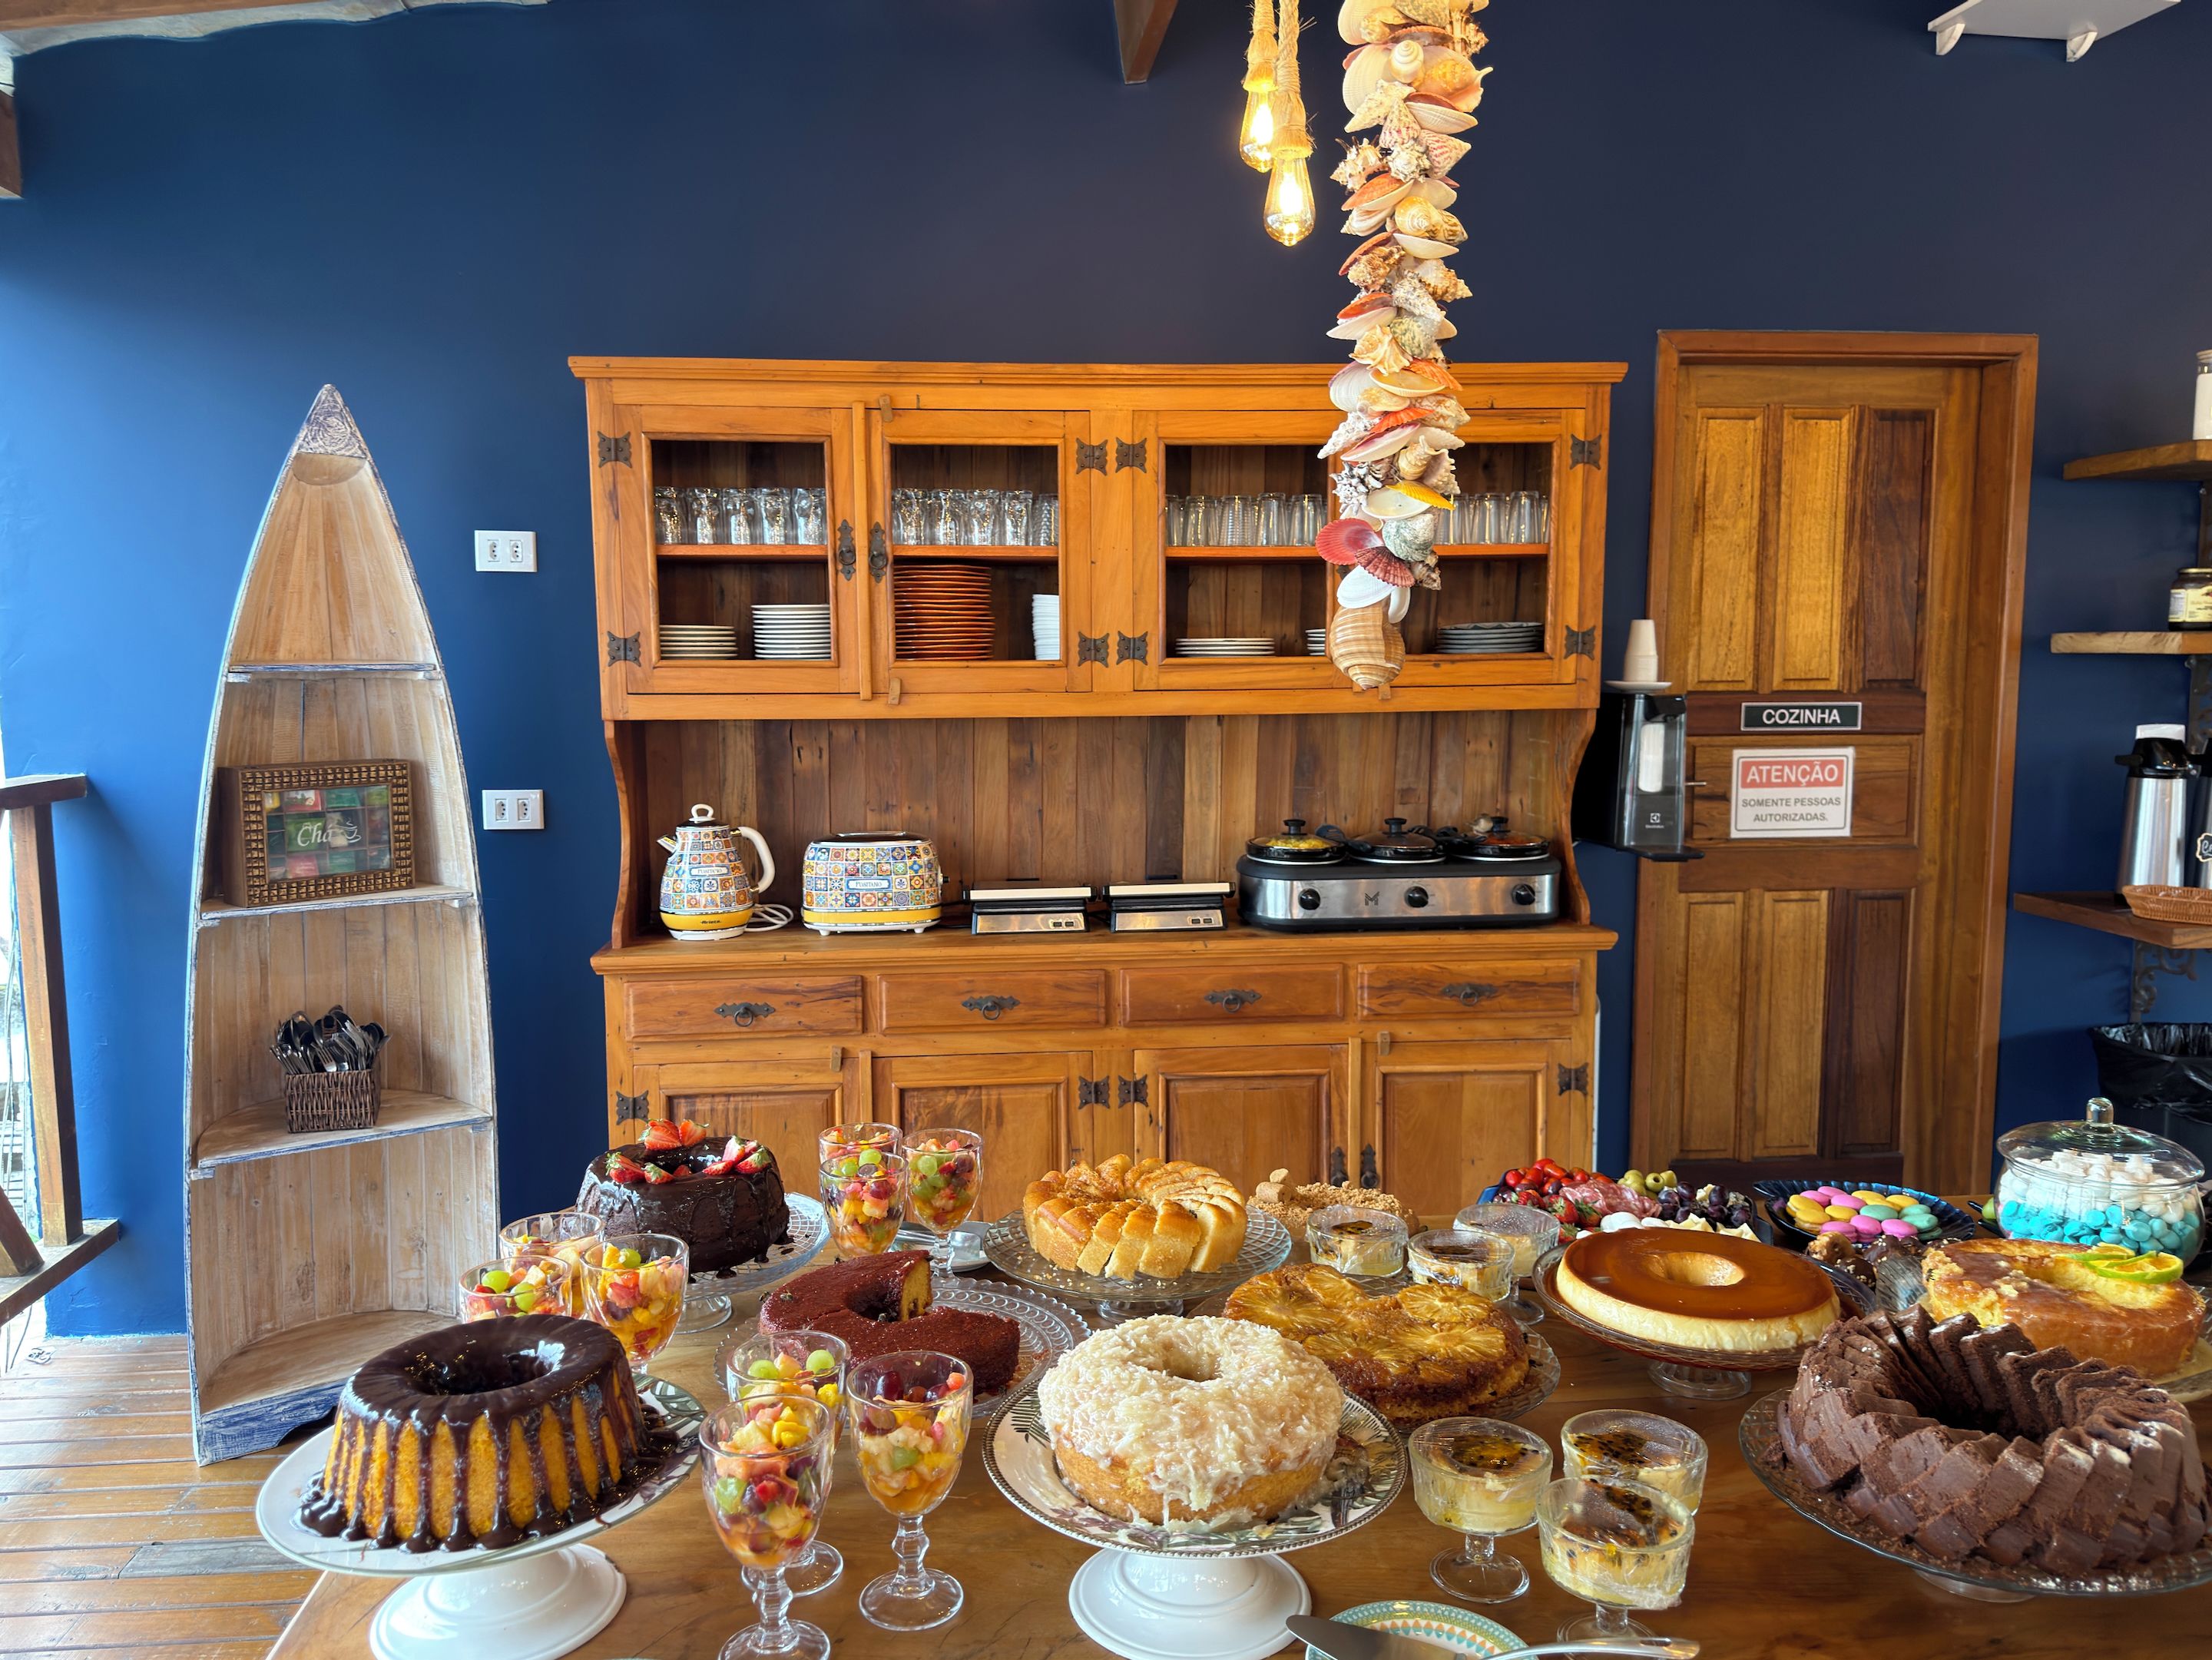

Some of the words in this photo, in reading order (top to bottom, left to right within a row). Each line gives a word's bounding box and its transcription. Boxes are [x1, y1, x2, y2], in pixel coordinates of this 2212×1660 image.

[1762, 708, 1841, 724] COZINHA
[1747, 761, 1839, 787] ATENÇÃO
[1742, 798, 1790, 807] SOMENTE
[1793, 797, 1841, 807] PESSOAS
[1753, 813, 1828, 822] AUTORIZADAS.
[297, 822, 333, 847] Chá
